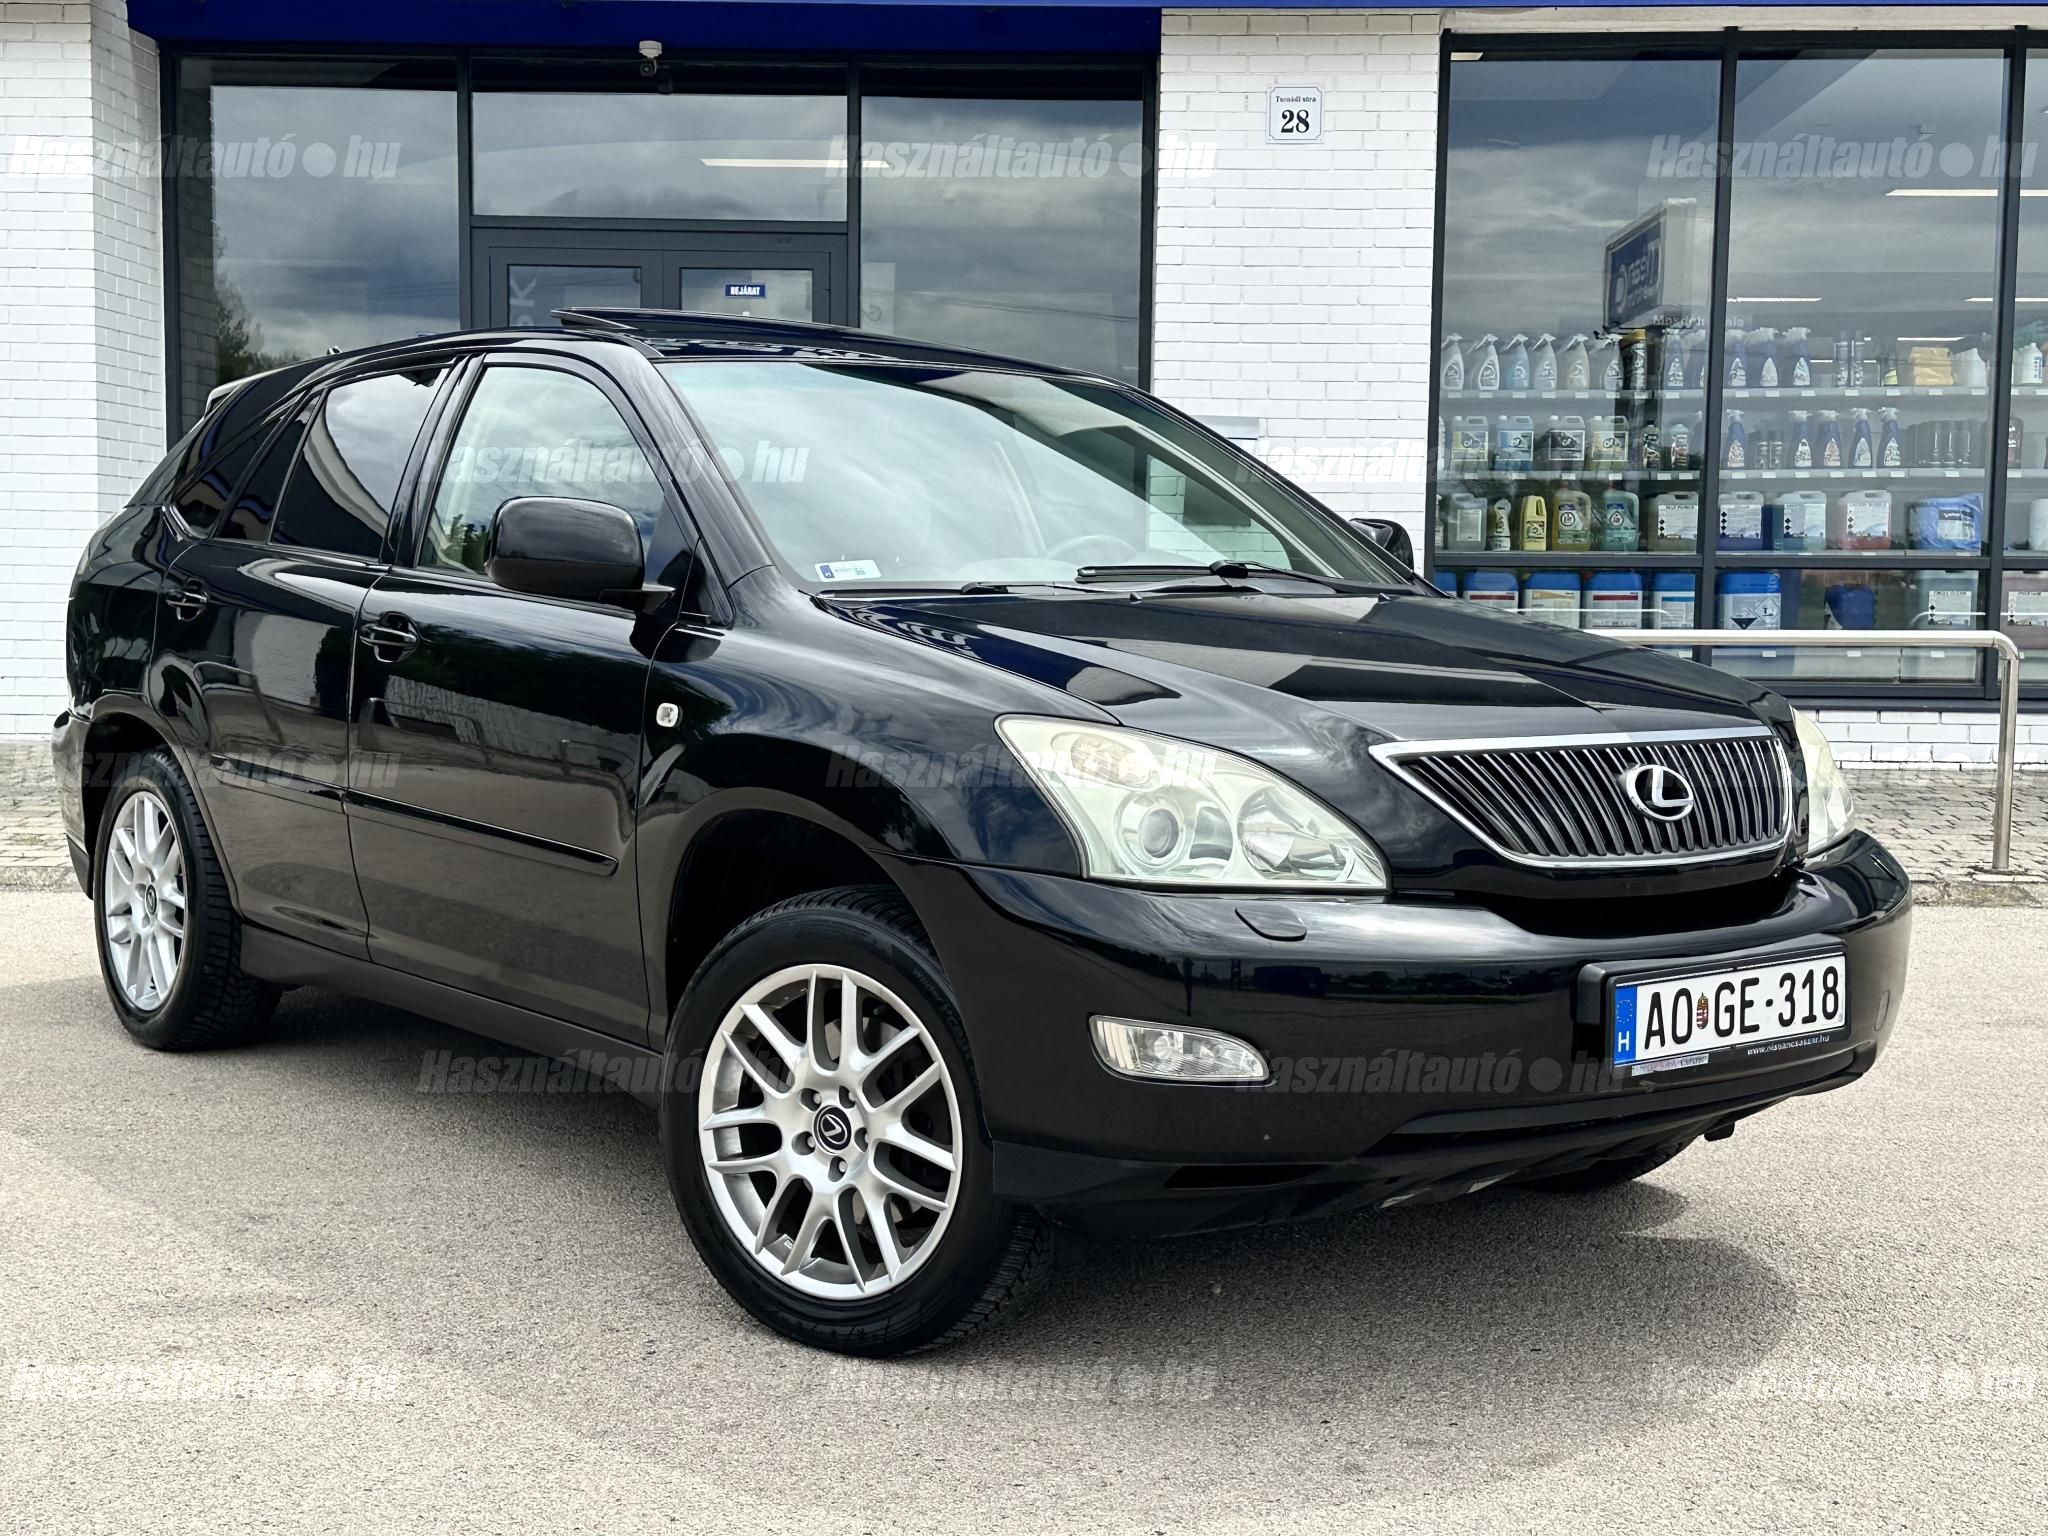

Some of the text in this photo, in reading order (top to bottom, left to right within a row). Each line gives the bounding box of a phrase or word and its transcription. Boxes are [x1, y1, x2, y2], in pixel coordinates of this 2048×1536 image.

[1280, 109, 1310, 133] 28
[1644, 966, 1839, 1050] AO GE-318
[1617, 1031, 1630, 1053] H
